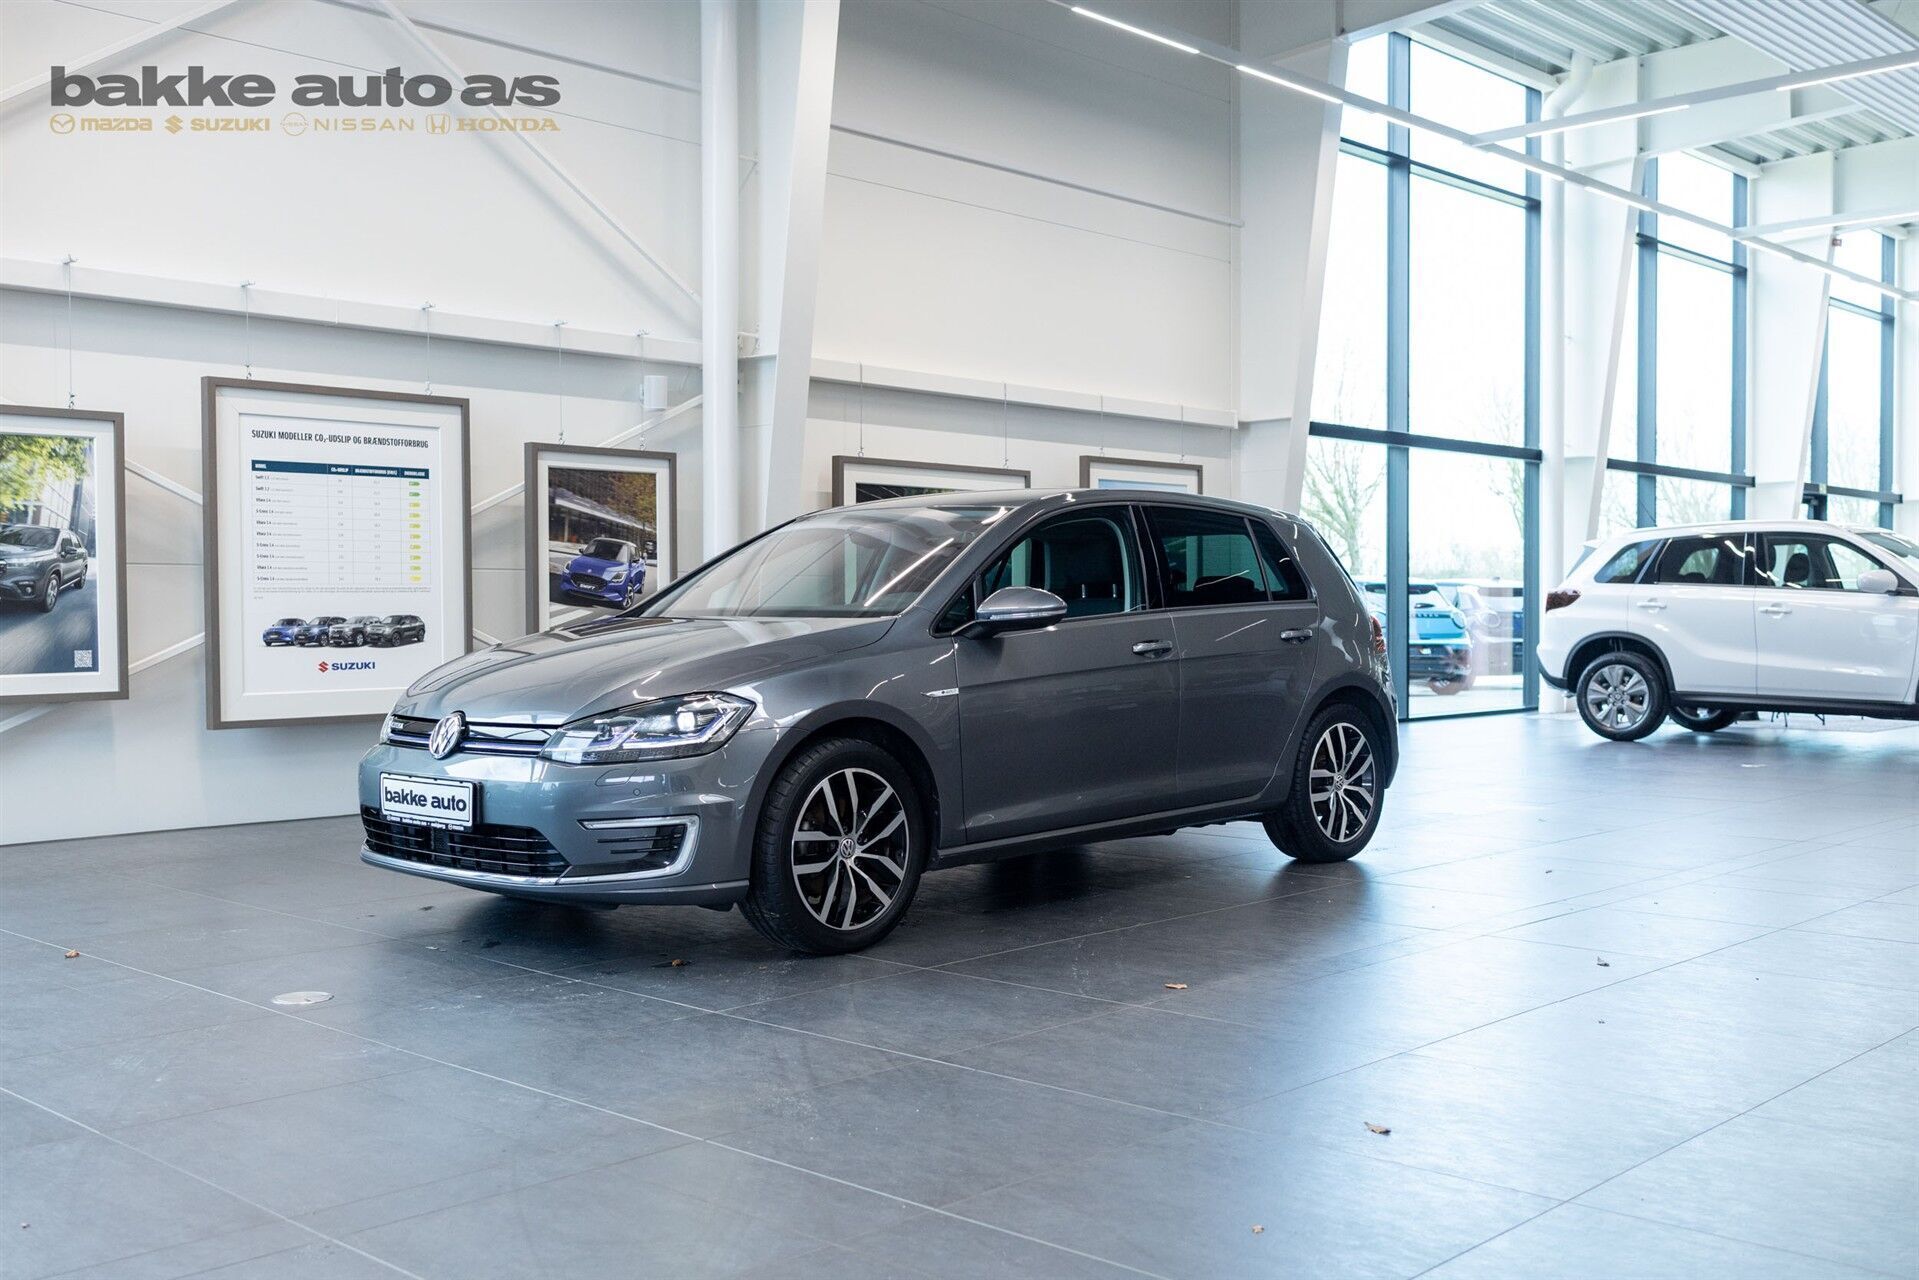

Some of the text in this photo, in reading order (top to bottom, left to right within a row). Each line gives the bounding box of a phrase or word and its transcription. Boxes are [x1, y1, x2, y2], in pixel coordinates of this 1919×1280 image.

[251, 429, 277, 440] SUZUKI
[278, 431, 313, 442] MODELLER
[353, 436, 362, 445] OG
[364, 436, 429, 448] BRÆNDSTOFFORBRUG
[332, 662, 376, 670] SUZUKI
[385, 786, 467, 812] bakke auto
